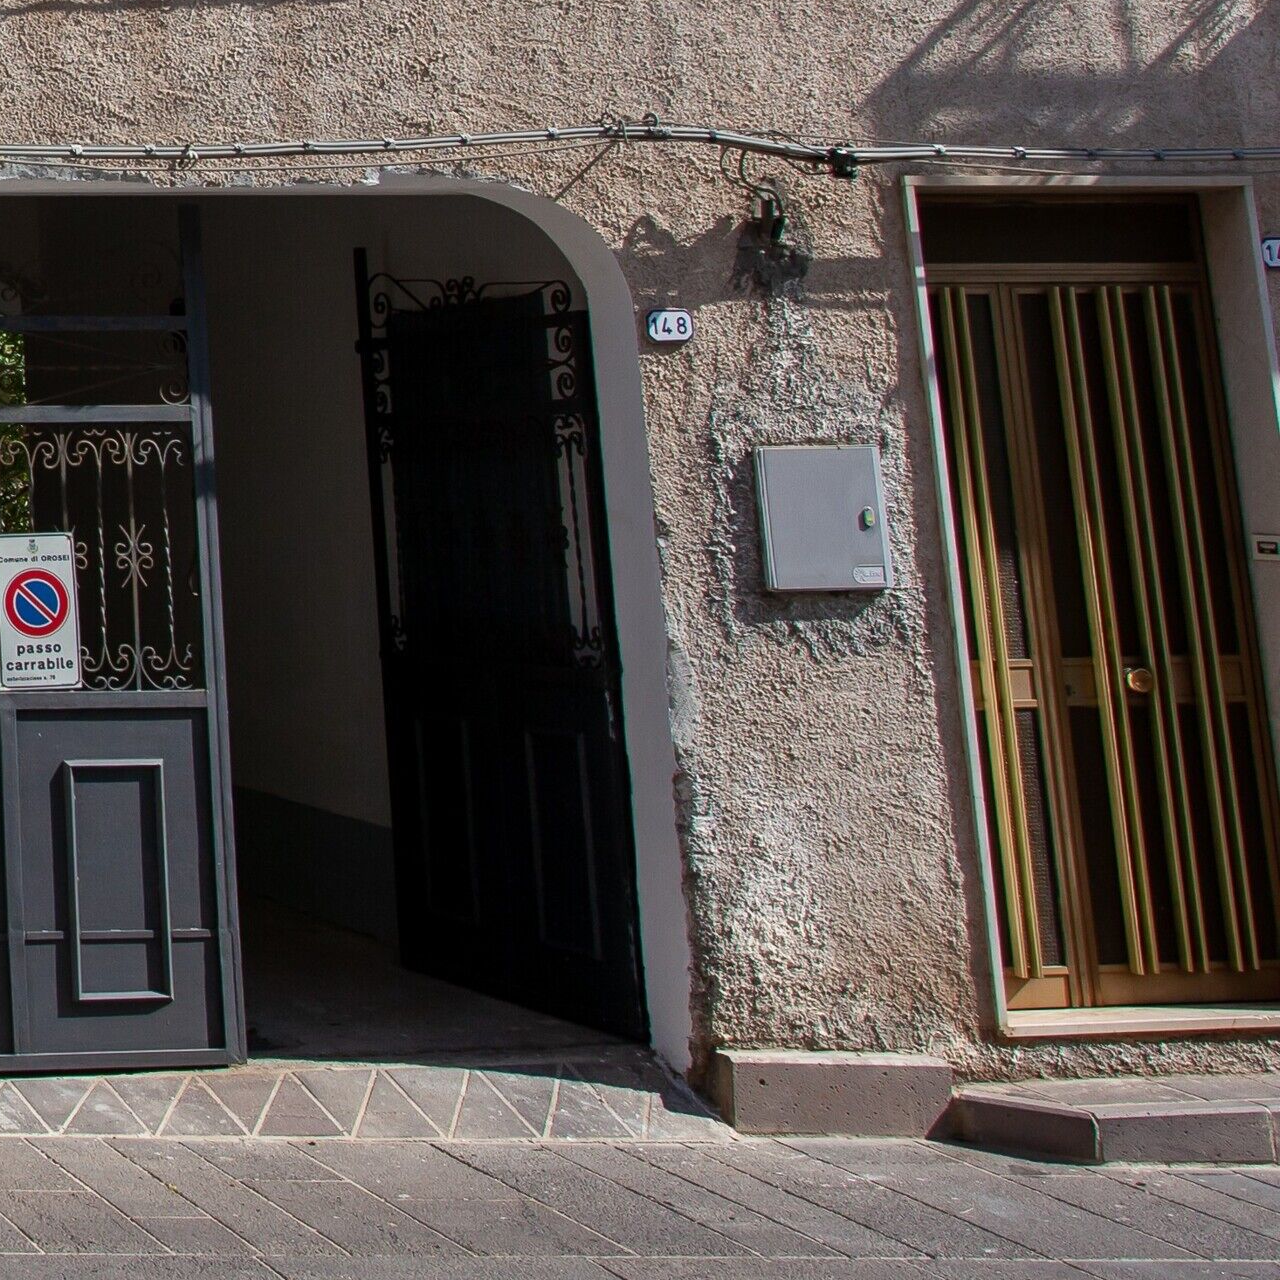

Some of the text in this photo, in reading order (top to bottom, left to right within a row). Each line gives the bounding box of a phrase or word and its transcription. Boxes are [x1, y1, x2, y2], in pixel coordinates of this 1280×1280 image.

[650, 316, 688, 335] 148
[30, 554, 38, 563] di
[40, 554, 70, 562] OROSEI
[16, 643, 62, 657] passo
[6, 657, 74, 671] carrabile
